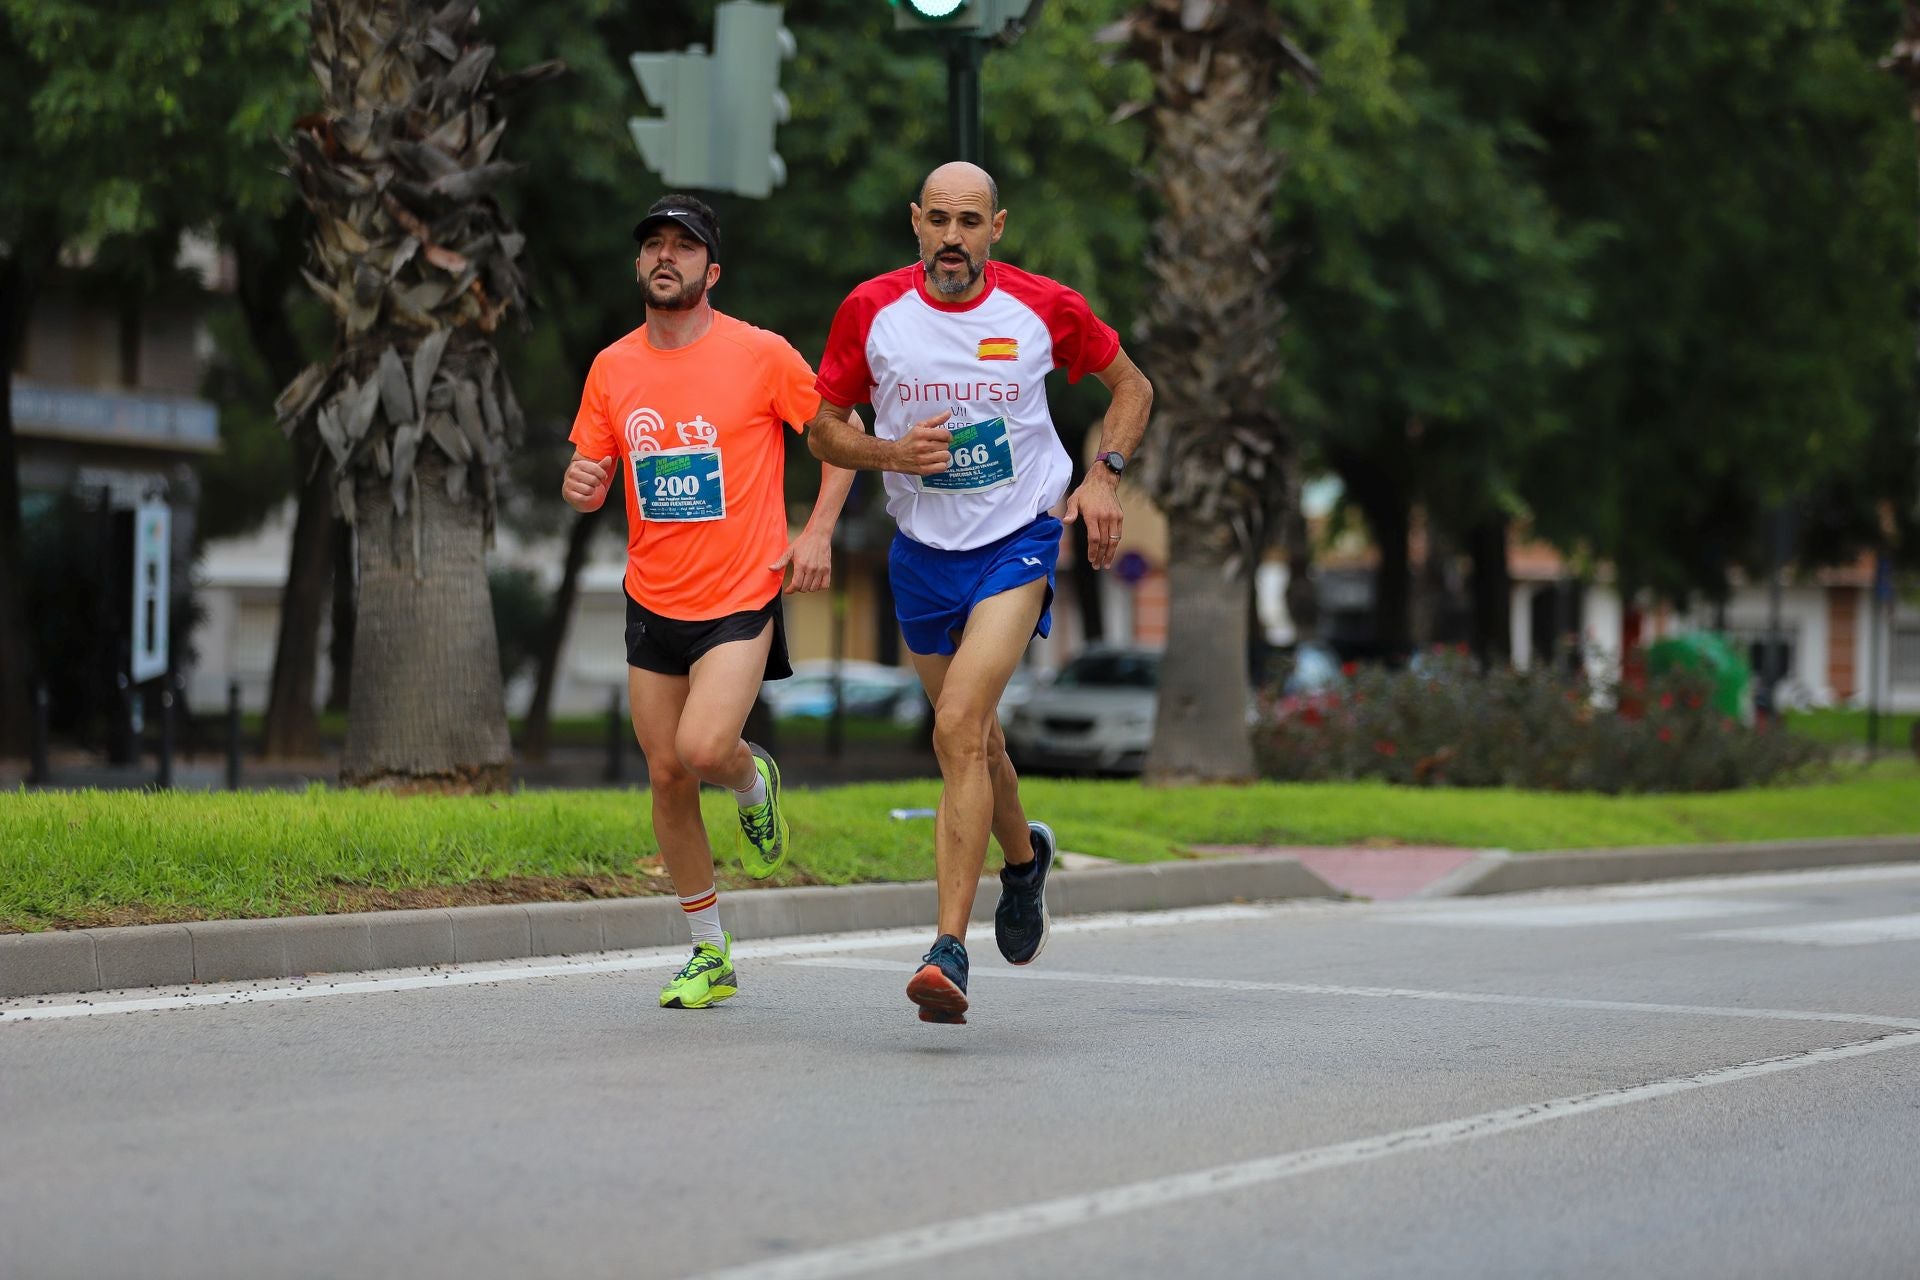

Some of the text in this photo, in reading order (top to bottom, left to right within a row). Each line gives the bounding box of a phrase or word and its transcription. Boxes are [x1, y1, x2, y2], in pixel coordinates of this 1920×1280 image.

[898, 378, 1020, 406] pimursa
[950, 406, 968, 417] VII
[946, 443, 989, 469] 66
[654, 476, 700, 496] 200
